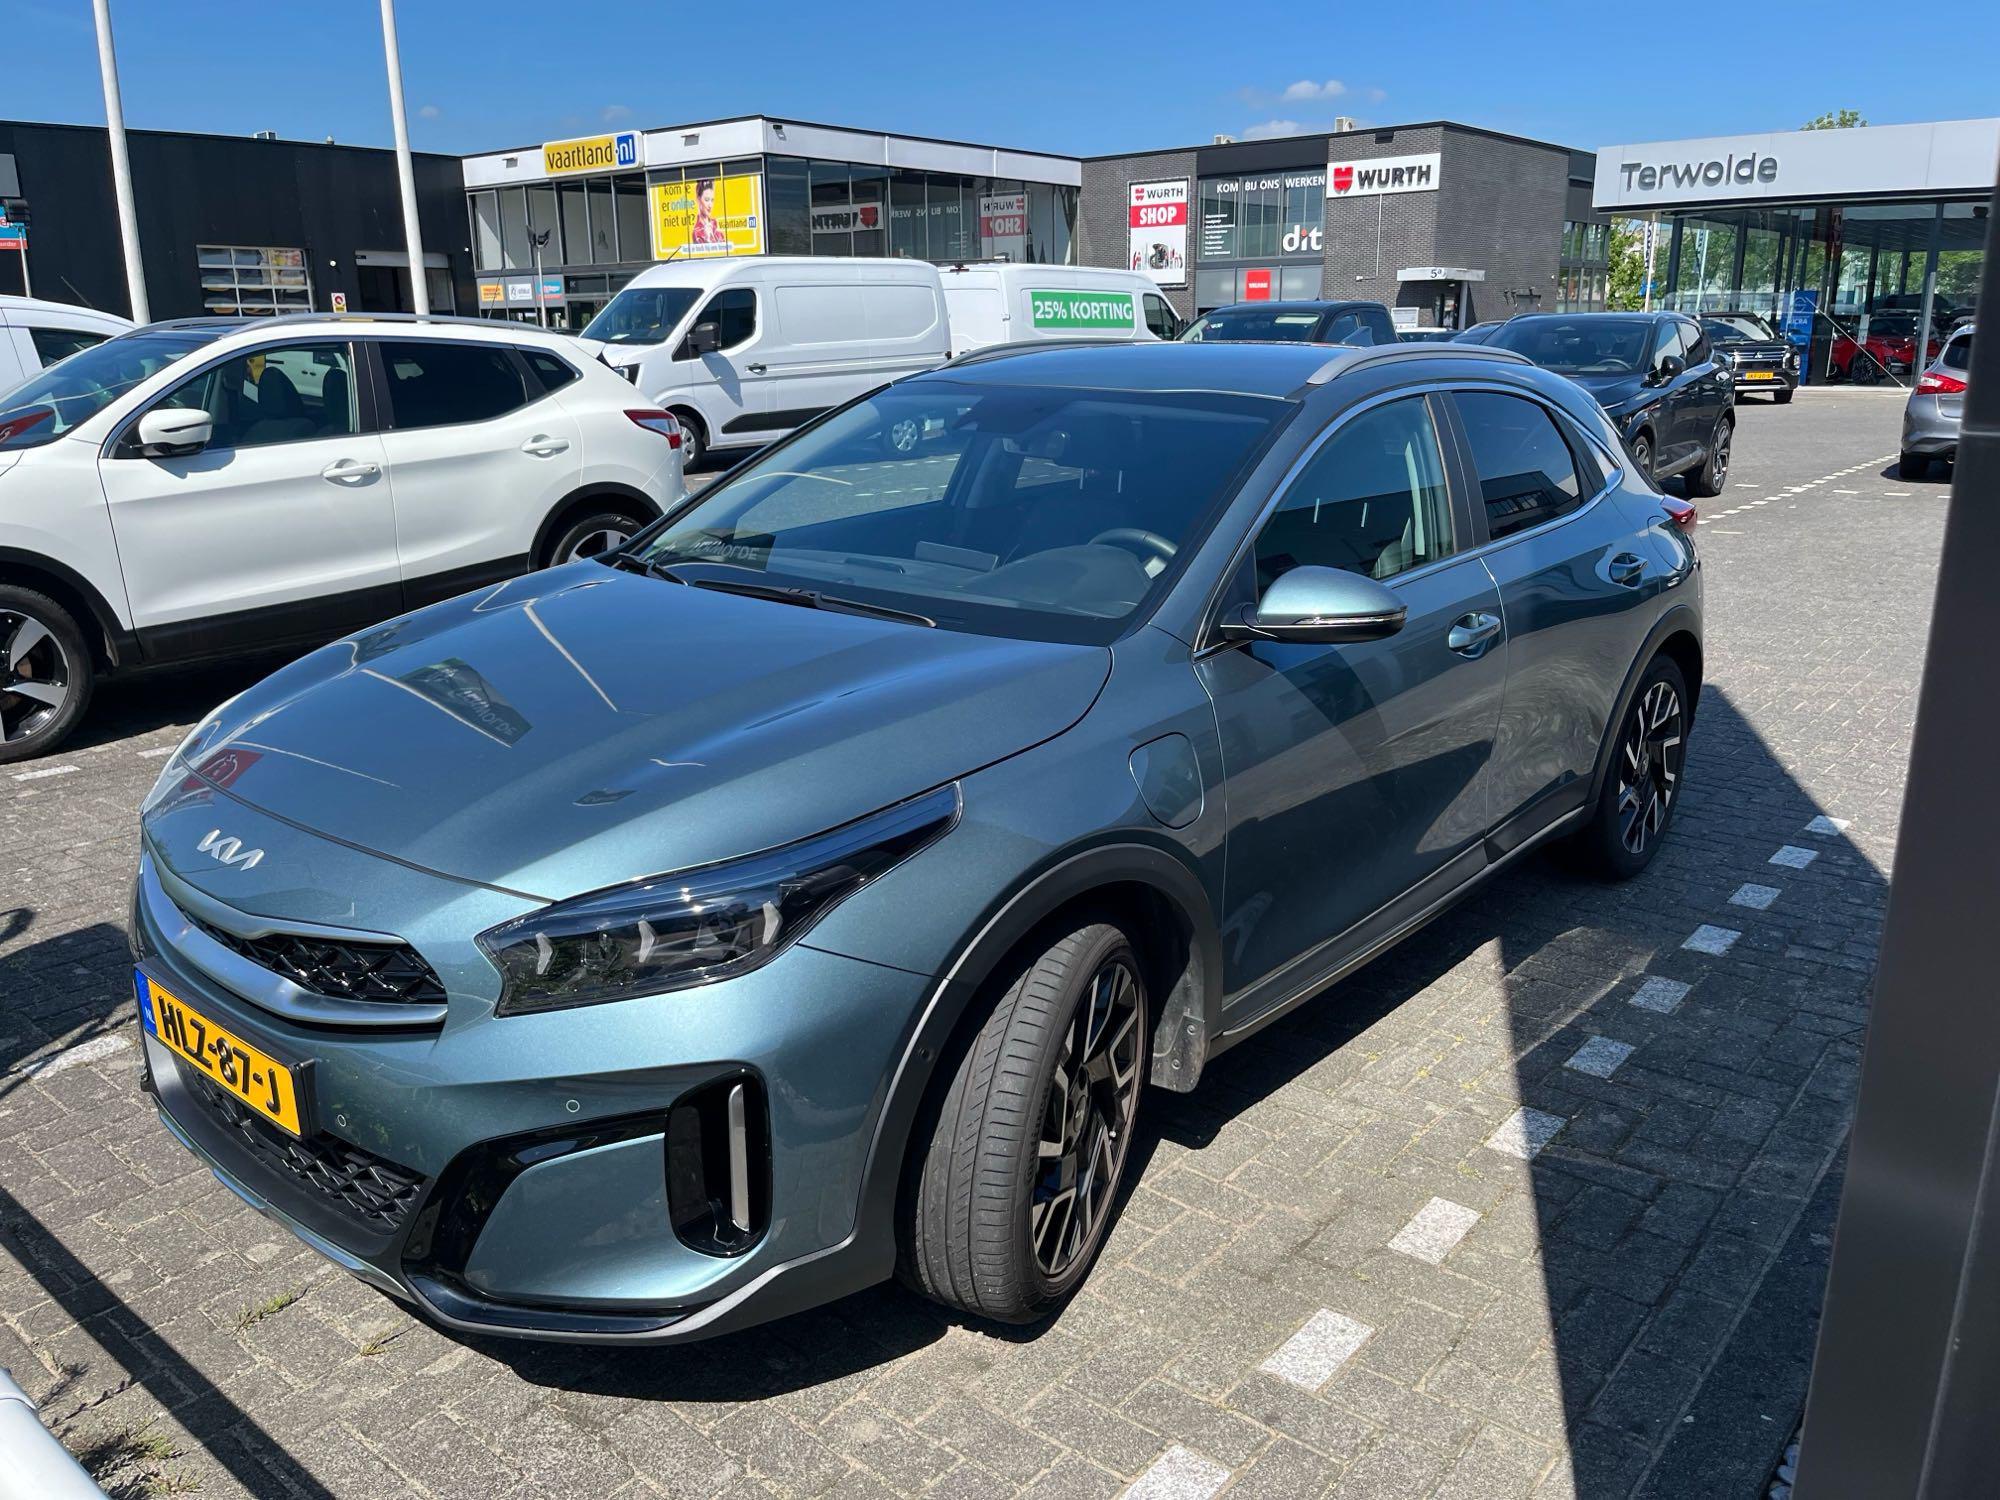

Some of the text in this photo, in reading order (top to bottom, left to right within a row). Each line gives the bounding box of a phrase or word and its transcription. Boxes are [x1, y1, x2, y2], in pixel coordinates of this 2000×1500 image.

[1620, 153, 1778, 191] Terwolde
[663, 184, 682, 196] kom
[1216, 175, 1326, 193] KOM BIJ ONS WERKEN
[663, 215, 679, 228] niet
[1139, 206, 1177, 225] SHOP
[1282, 225, 1323, 252] dit
[1034, 301, 1133, 320] 25% KORTING
[157, 995, 282, 1116] HLZ-87-J
